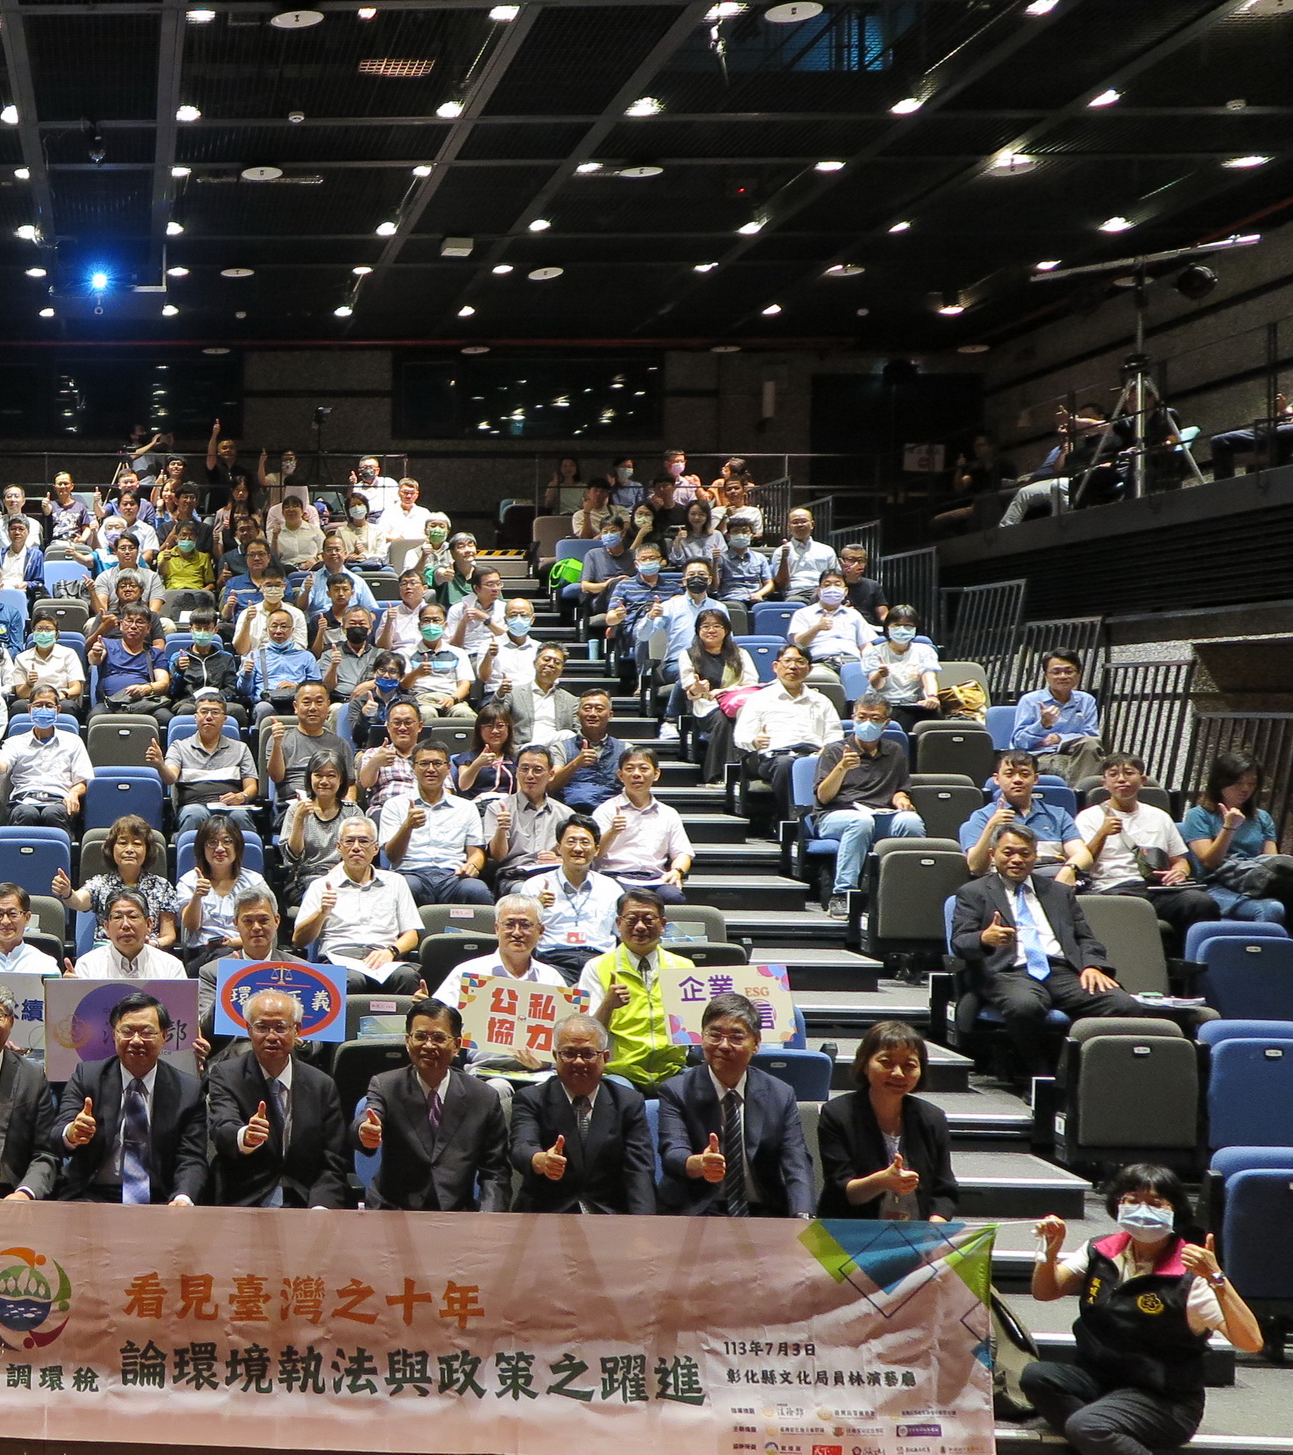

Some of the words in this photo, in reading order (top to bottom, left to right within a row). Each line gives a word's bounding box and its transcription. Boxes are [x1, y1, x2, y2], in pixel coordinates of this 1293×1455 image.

[490, 987, 557, 1022] 公私
[744, 986, 770, 997] ESG
[487, 1016, 555, 1052] 協力
[122, 1272, 485, 1330] 看見臺灣之十年
[723, 1341, 816, 1357] 113年7月3日
[120, 1340, 706, 1406] 論環境執法與政策之躍進
[727, 1369, 917, 1387] 彰化縣文化局員林演藝廳
